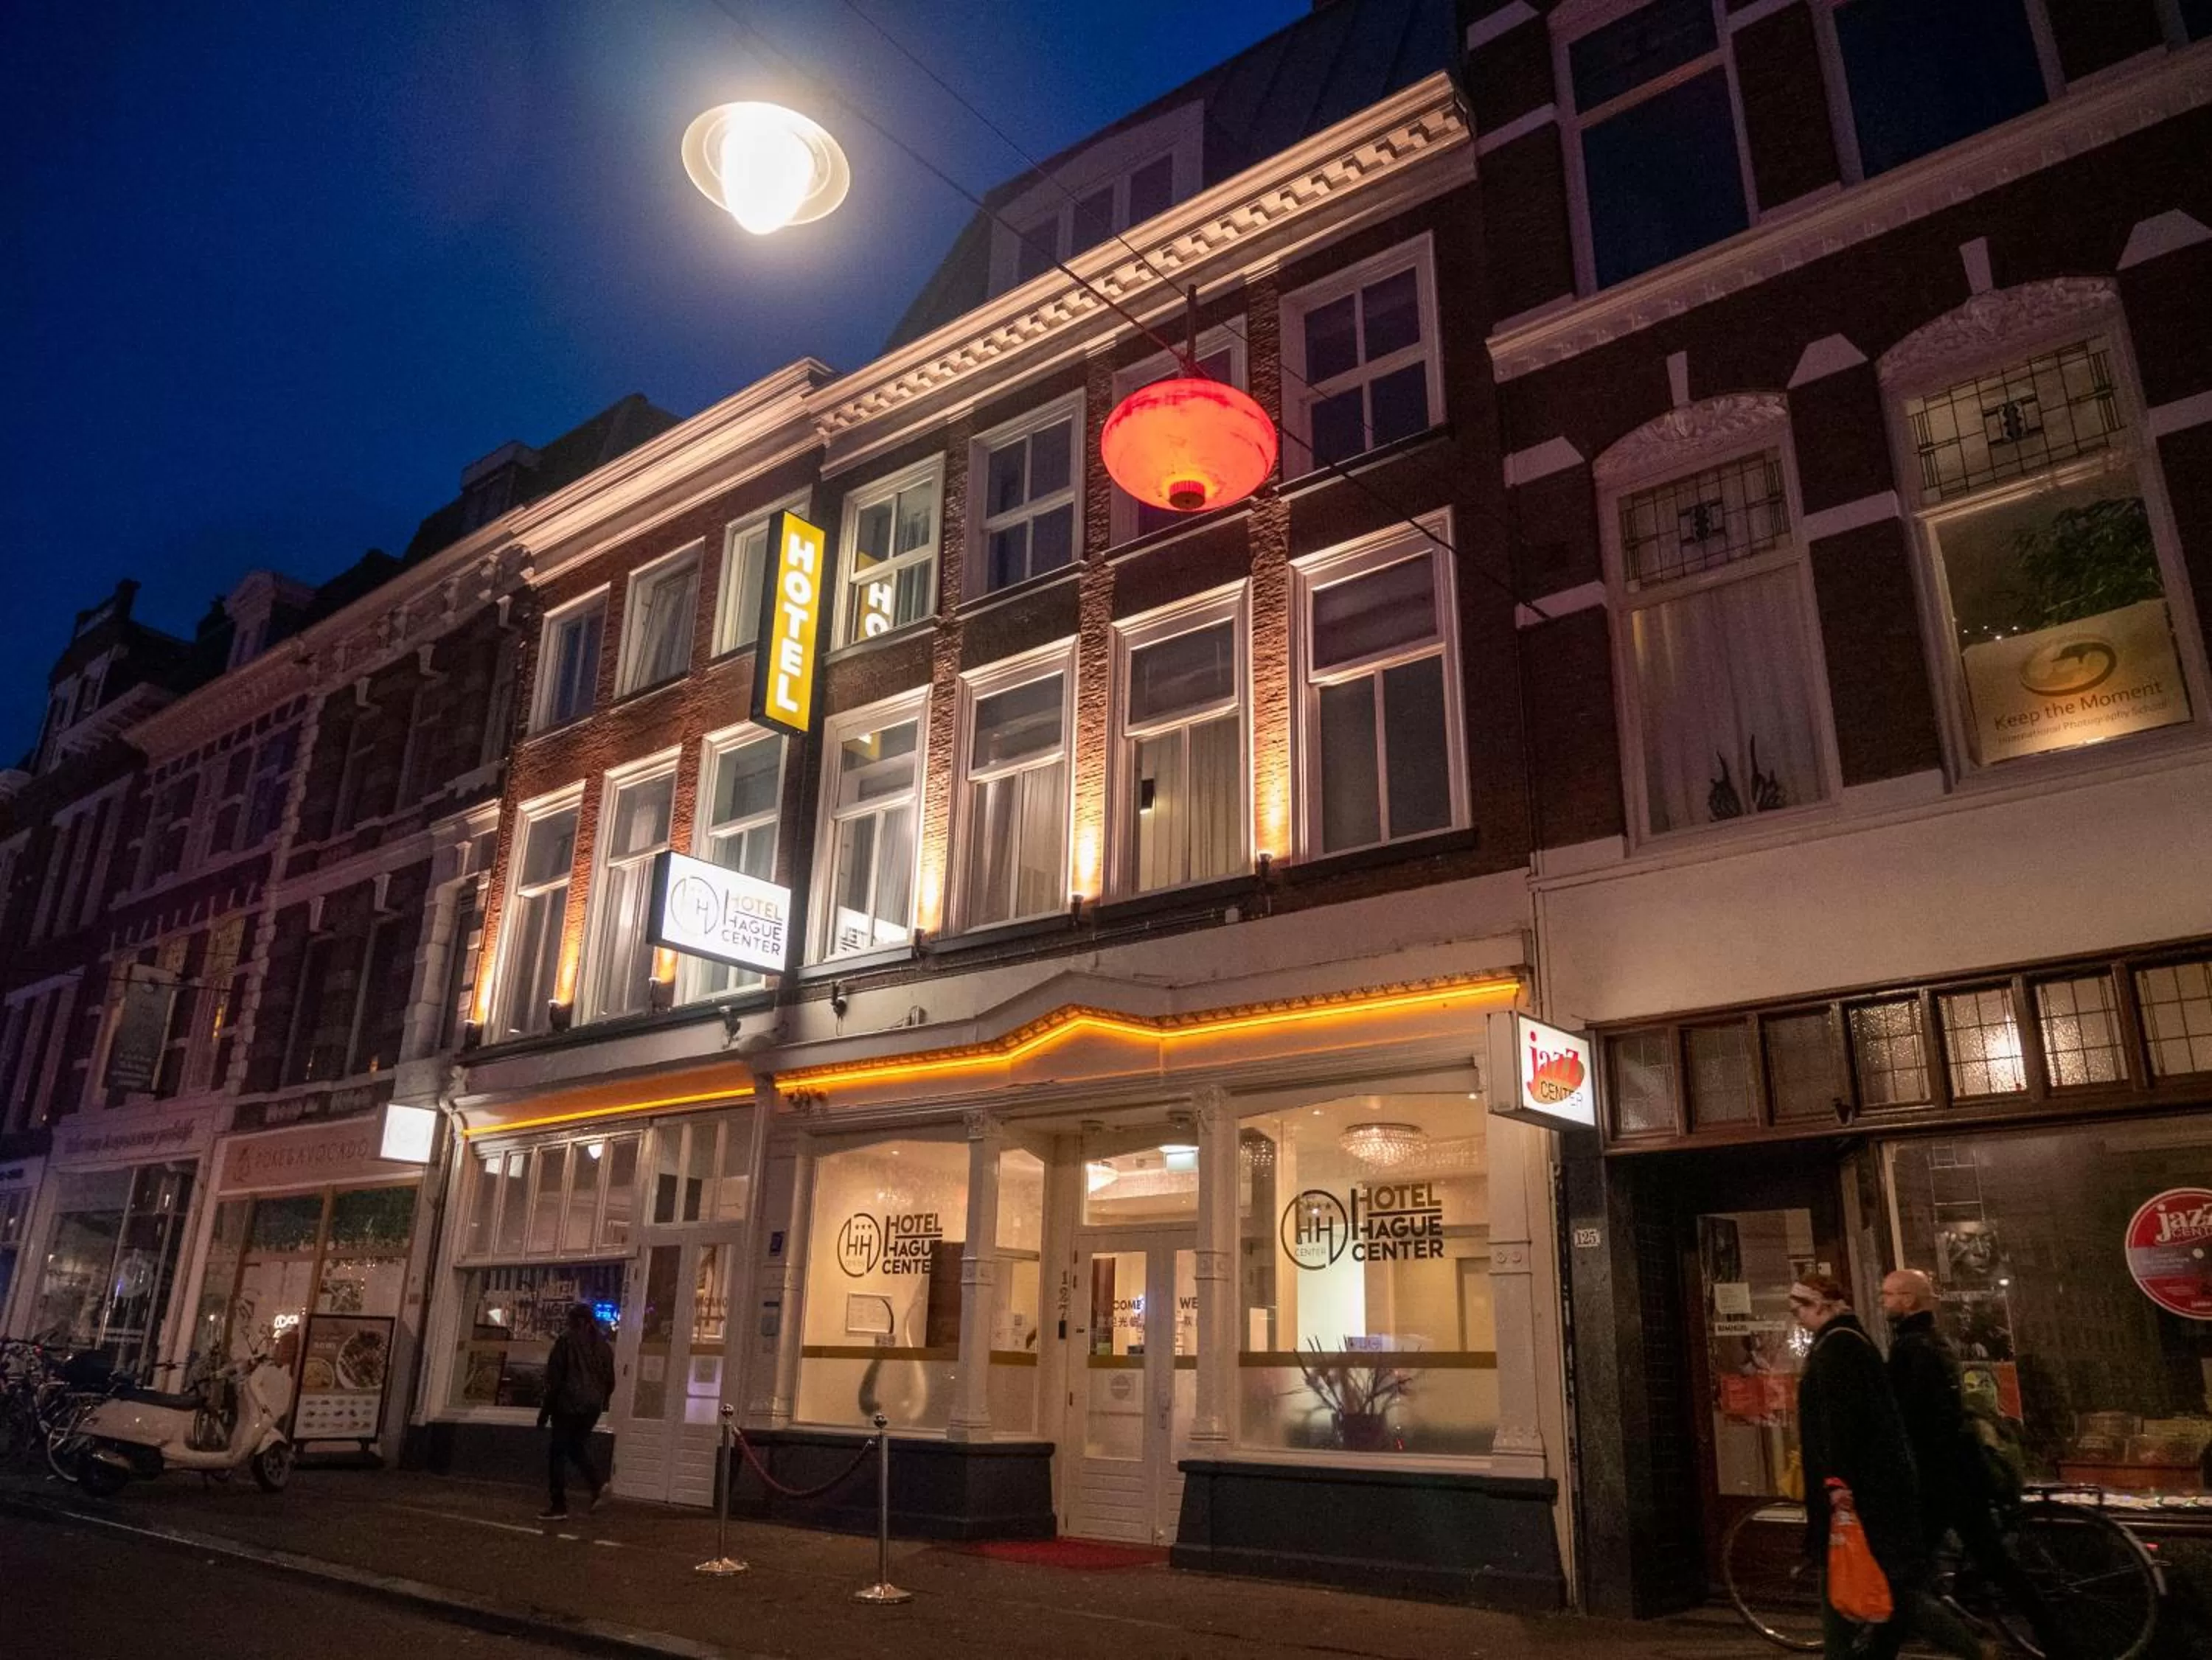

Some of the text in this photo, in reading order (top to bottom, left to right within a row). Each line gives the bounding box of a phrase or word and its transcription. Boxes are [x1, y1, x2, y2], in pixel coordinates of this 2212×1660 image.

[776, 532, 815, 713] HOTEL
[1993, 680, 2164, 731] Keep the Moment
[2064, 710, 2129, 732] Photography
[723, 888, 783, 921] HOTEL
[723, 915, 782, 941] HAGUE
[721, 929, 782, 956] CENTER
[1526, 1030, 1581, 1098] jazz
[1350, 1182, 1442, 1210] HOTEL
[883, 1213, 943, 1234] HOTEL
[1350, 1215, 1443, 1240] HAGUE
[1576, 1230, 1596, 1245] 125
[1294, 1246, 1326, 1258] CENTER
[1352, 1239, 1444, 1263] CENTER
[882, 1258, 936, 1274] CENTE
